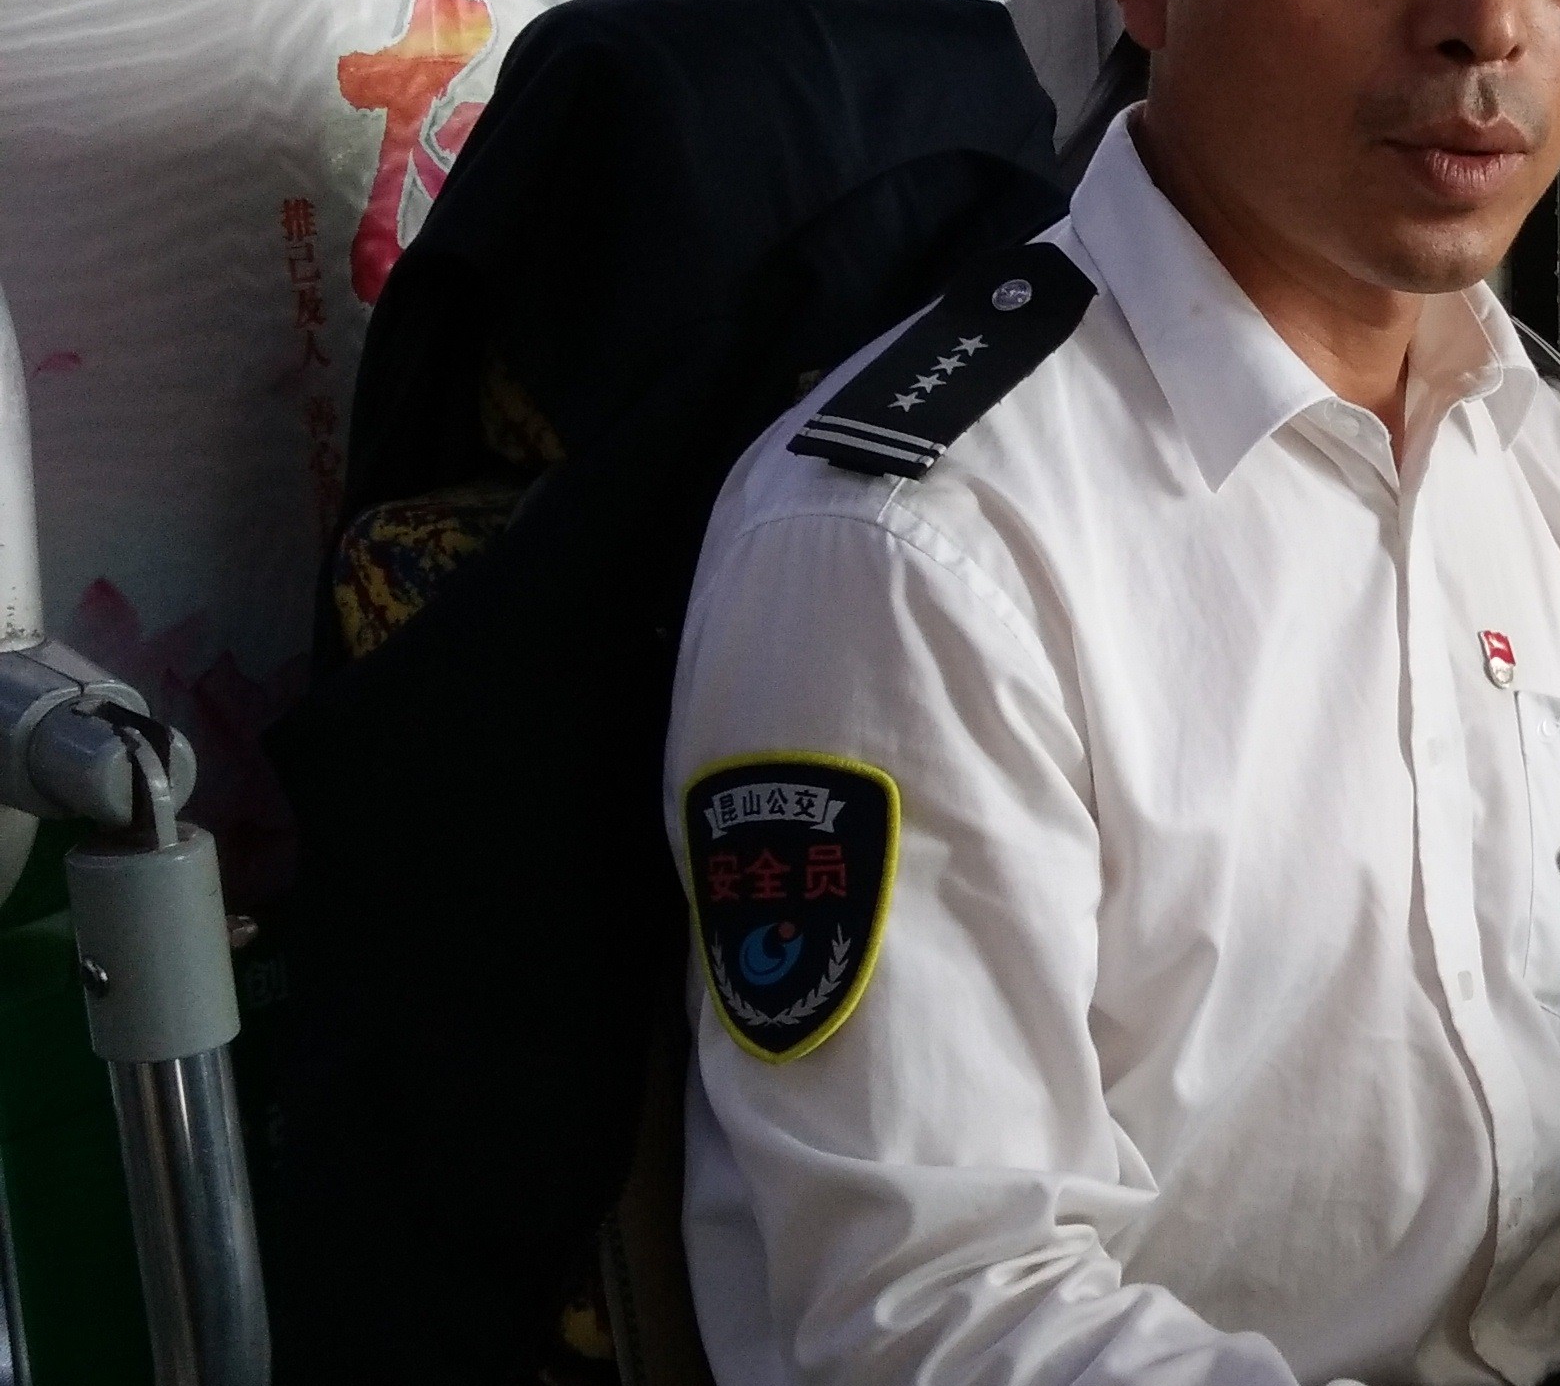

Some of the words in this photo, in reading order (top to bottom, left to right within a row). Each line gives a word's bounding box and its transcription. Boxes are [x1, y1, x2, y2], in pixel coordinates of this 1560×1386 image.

[281, 198, 330, 367] 推己及人
[719, 787, 817, 824] 昆山公交
[707, 844, 848, 901] 安全员
